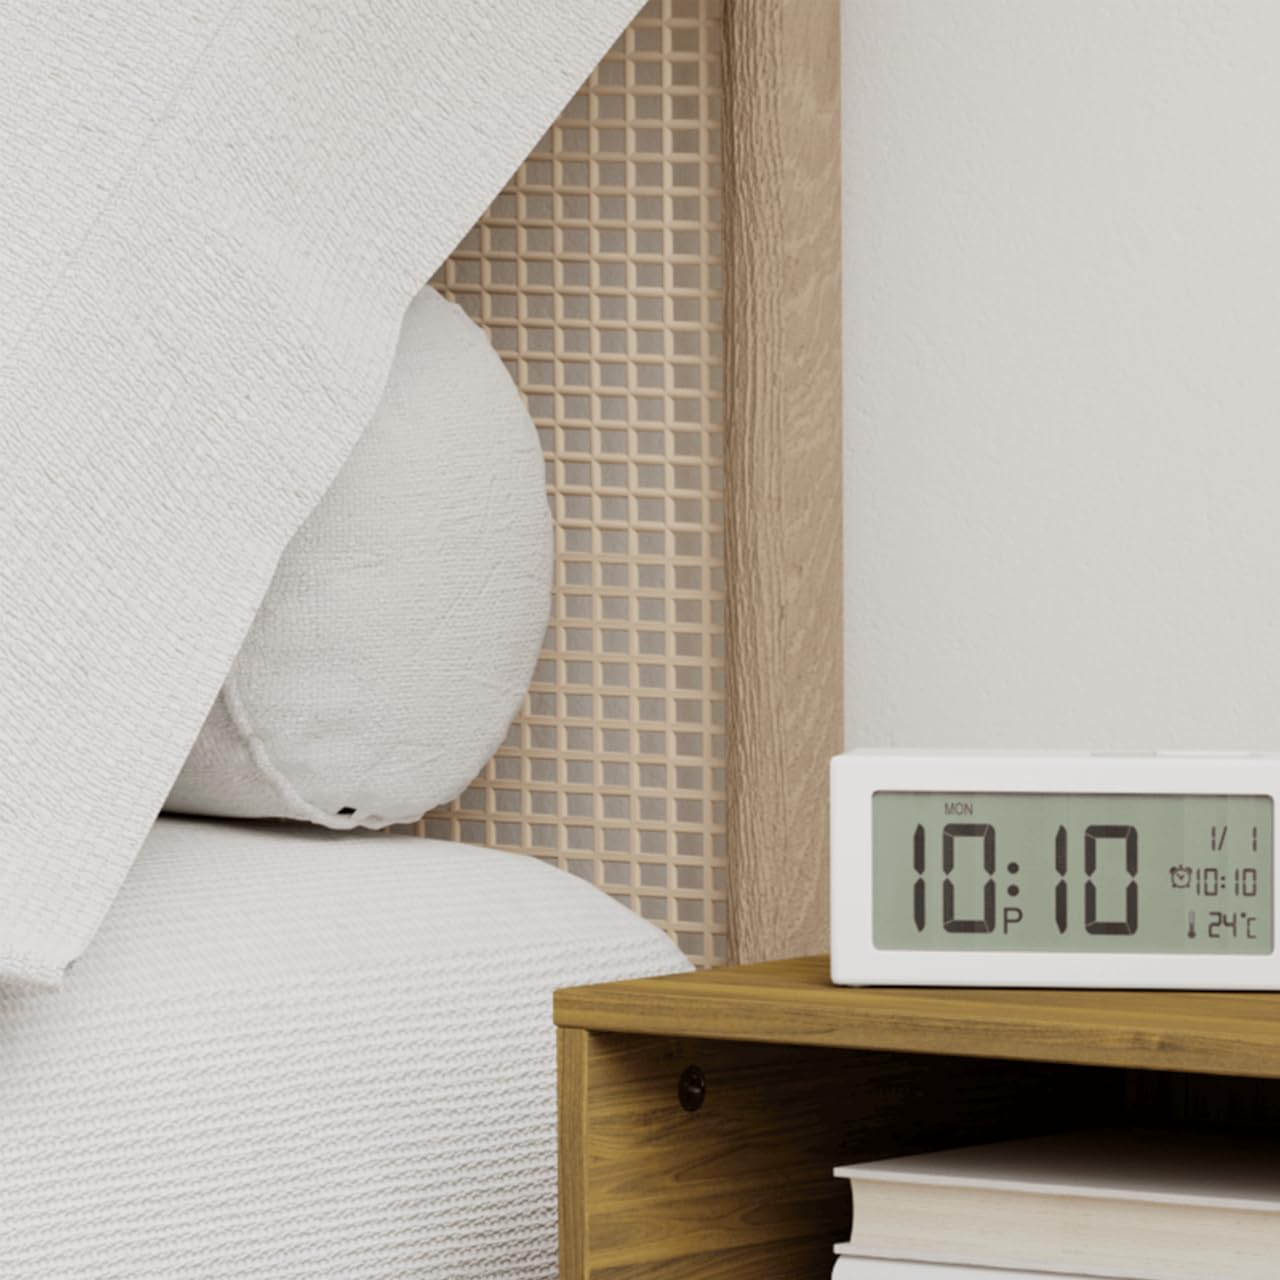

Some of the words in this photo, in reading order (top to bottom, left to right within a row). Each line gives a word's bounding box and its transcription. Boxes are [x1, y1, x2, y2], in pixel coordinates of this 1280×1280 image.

[944, 802, 974, 816] MON
[913, 823, 1139, 936] 10:10
[1195, 867, 1257, 897] 10:10
[1003, 906, 1024, 935] P
